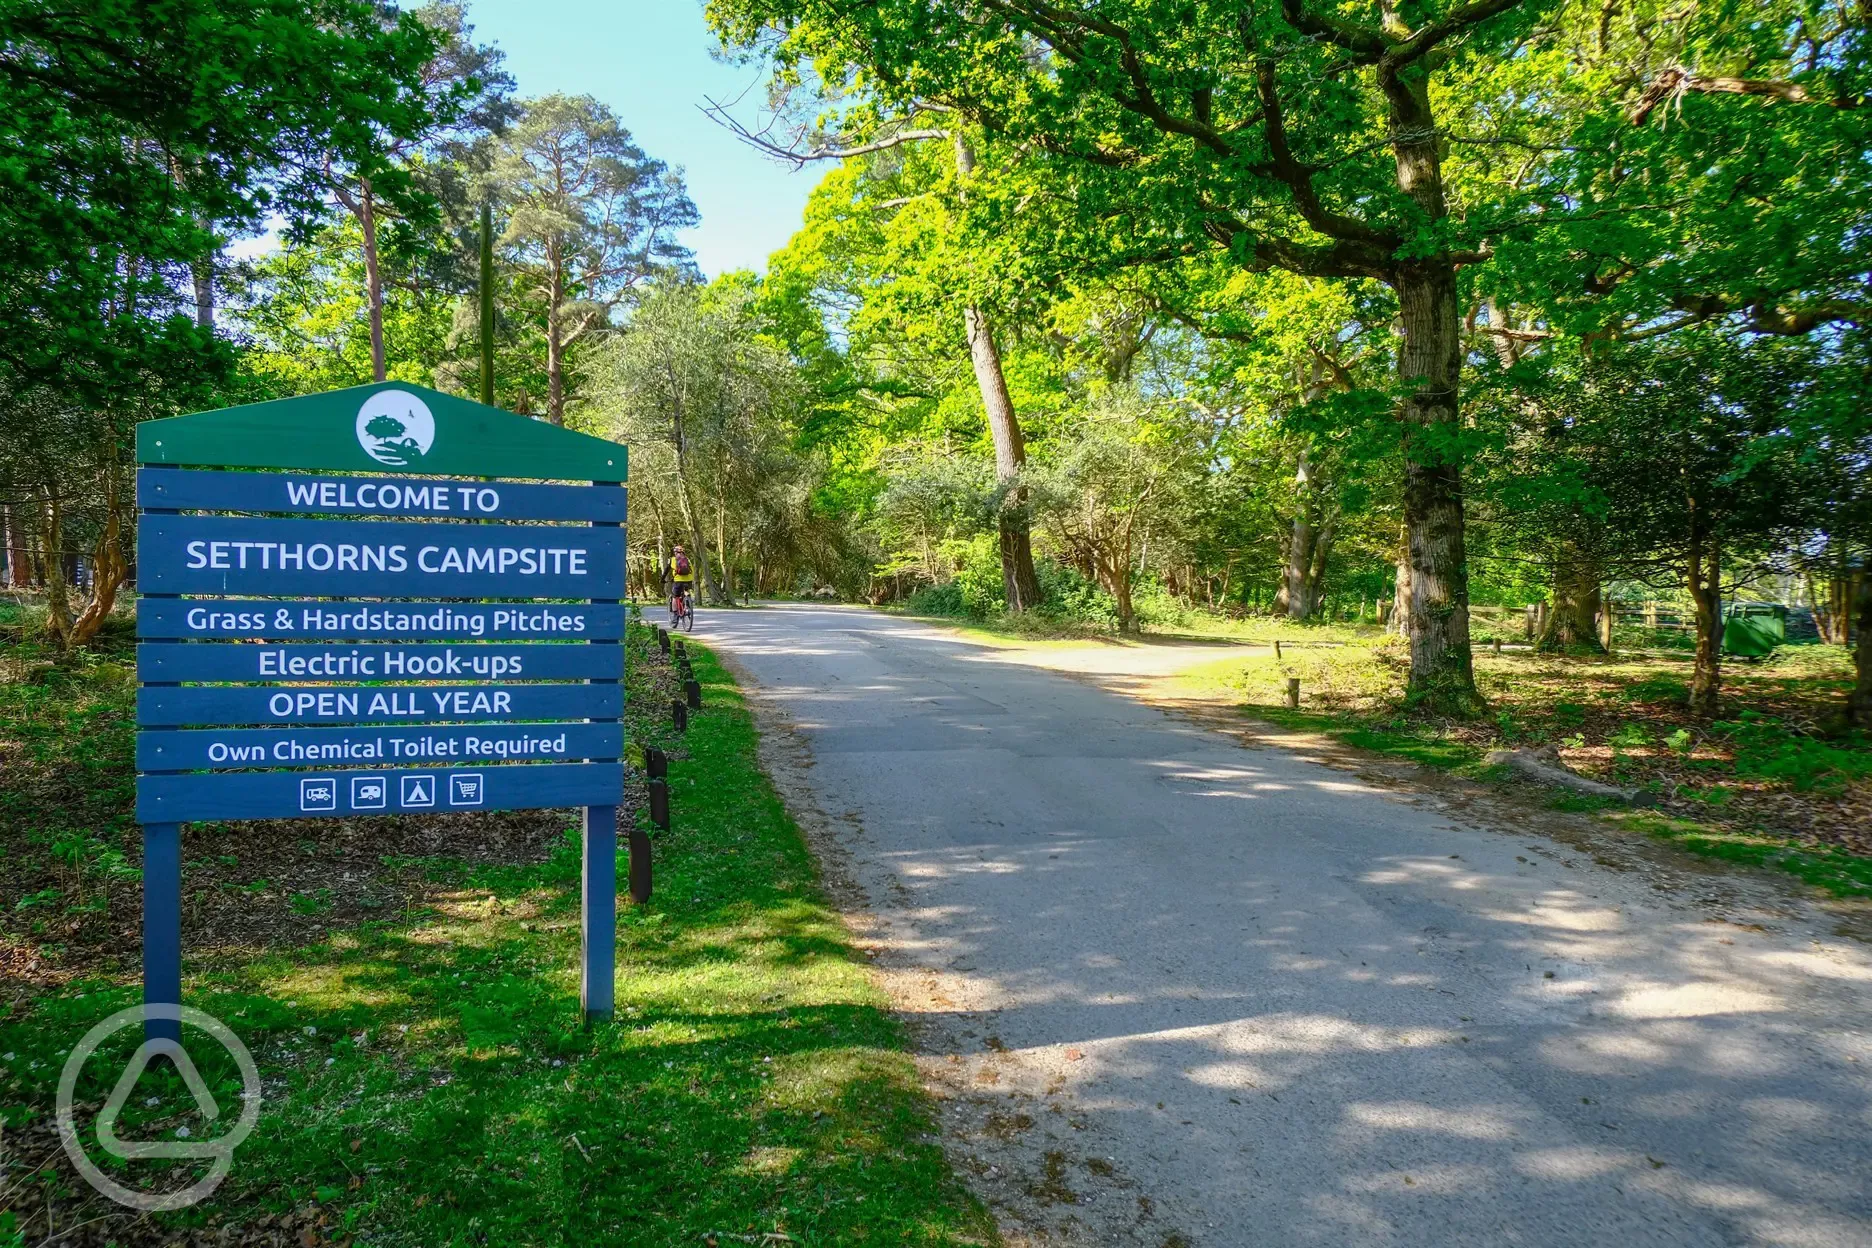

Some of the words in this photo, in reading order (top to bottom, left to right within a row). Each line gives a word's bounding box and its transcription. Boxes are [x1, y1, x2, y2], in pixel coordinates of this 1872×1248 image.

[286, 481, 449, 511] WELCOME
[457, 488, 500, 513] TO
[186, 541, 408, 573] SETTHORNS
[417, 546, 587, 575] CAMPSITE
[186, 608, 266, 631] Grass
[273, 609, 294, 631] &
[302, 609, 485, 635] Hardstanding
[493, 609, 585, 632] Pitches
[259, 650, 375, 676] Electric
[384, 649, 523, 680] Hook-ups
[269, 693, 358, 717] OPEN
[367, 692, 425, 716] ALL
[432, 691, 512, 714] YEAR
[208, 743, 265, 762] Own
[273, 738, 383, 761] Chemical
[389, 737, 459, 758] Toilet
[465, 734, 566, 758] Required
